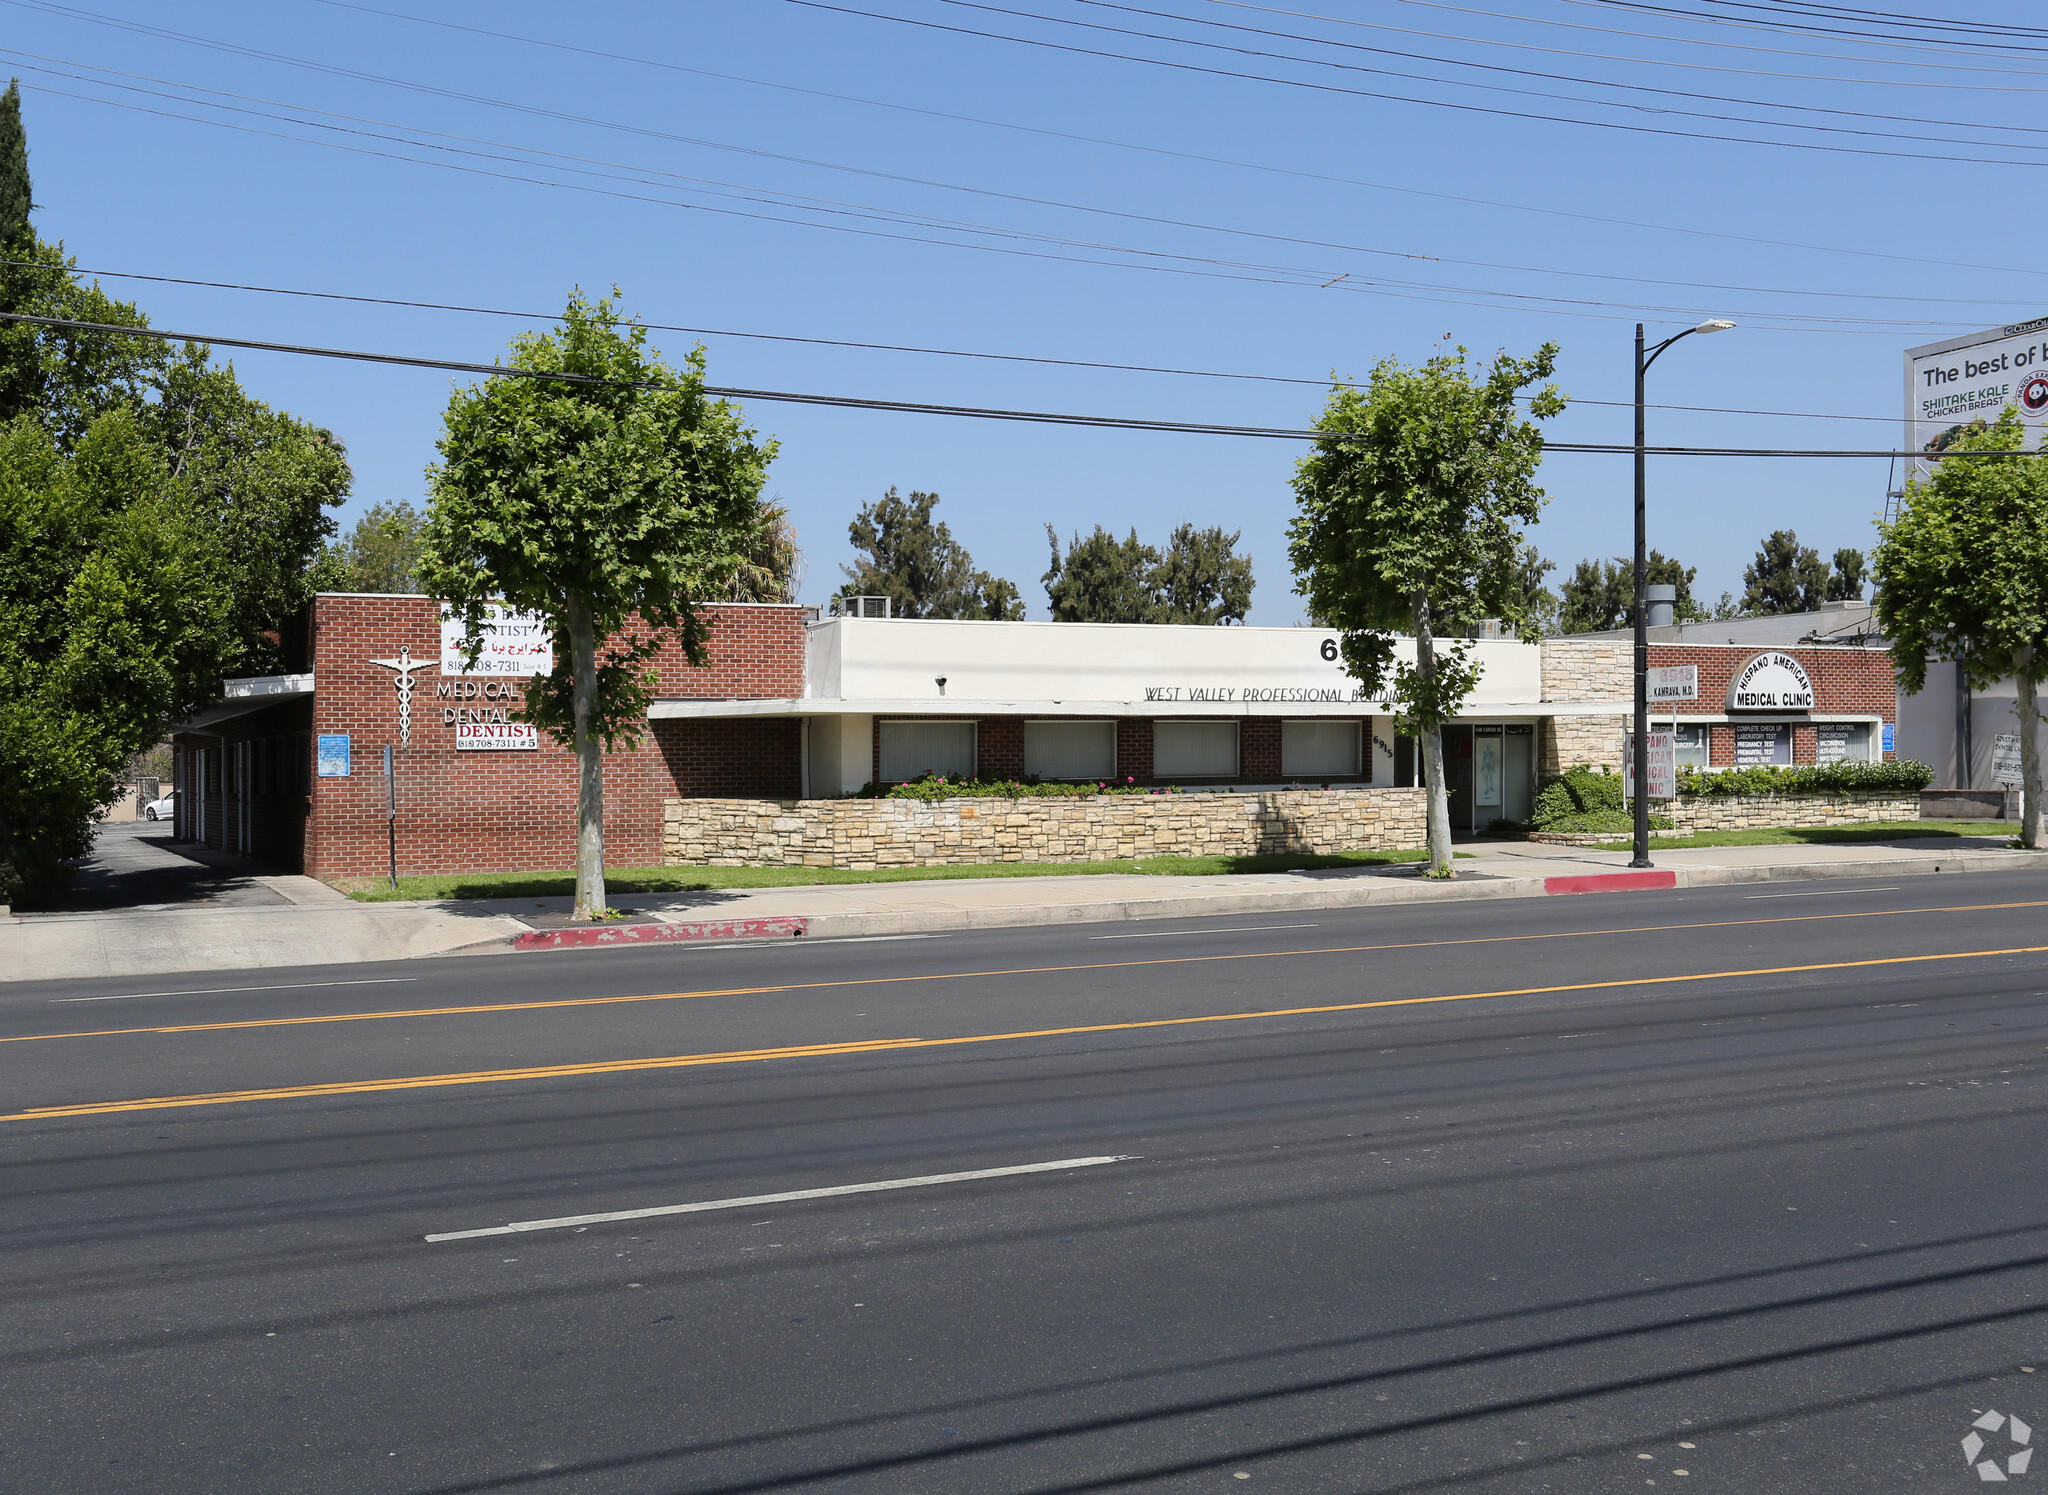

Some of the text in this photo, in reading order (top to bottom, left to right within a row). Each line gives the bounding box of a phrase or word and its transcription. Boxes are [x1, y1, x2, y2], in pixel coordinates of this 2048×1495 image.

[1923, 367, 1959, 387] The
[1965, 353, 2009, 378] best
[2014, 345, 2037, 367] of
[2018, 372, 2048, 398] PANDA EXP
[1922, 384, 2009, 411] SHIITAKE KALE
[1927, 396, 2004, 419] CHICKEN BREAST
[447, 660, 520, 672] 81808-7311
[1739, 655, 1809, 690] HISPANO AMERICAN
[1660, 668, 1694, 682] 6915
[436, 681, 519, 698] MEDICAL
[1144, 687, 1181, 702] WEST
[1189, 687, 1236, 702] VALLEY
[1243, 688, 1344, 702] PROFESSIONAL
[1682, 685, 1694, 696] M.D.
[1737, 693, 1812, 706] MEDICAL CLINIC
[444, 708, 512, 723] DENTAL
[459, 725, 536, 738] DENTIST
[528, 739, 535, 748] 5
[1373, 735, 1393, 758] 6915
[1630, 766, 1669, 779] MICAL
